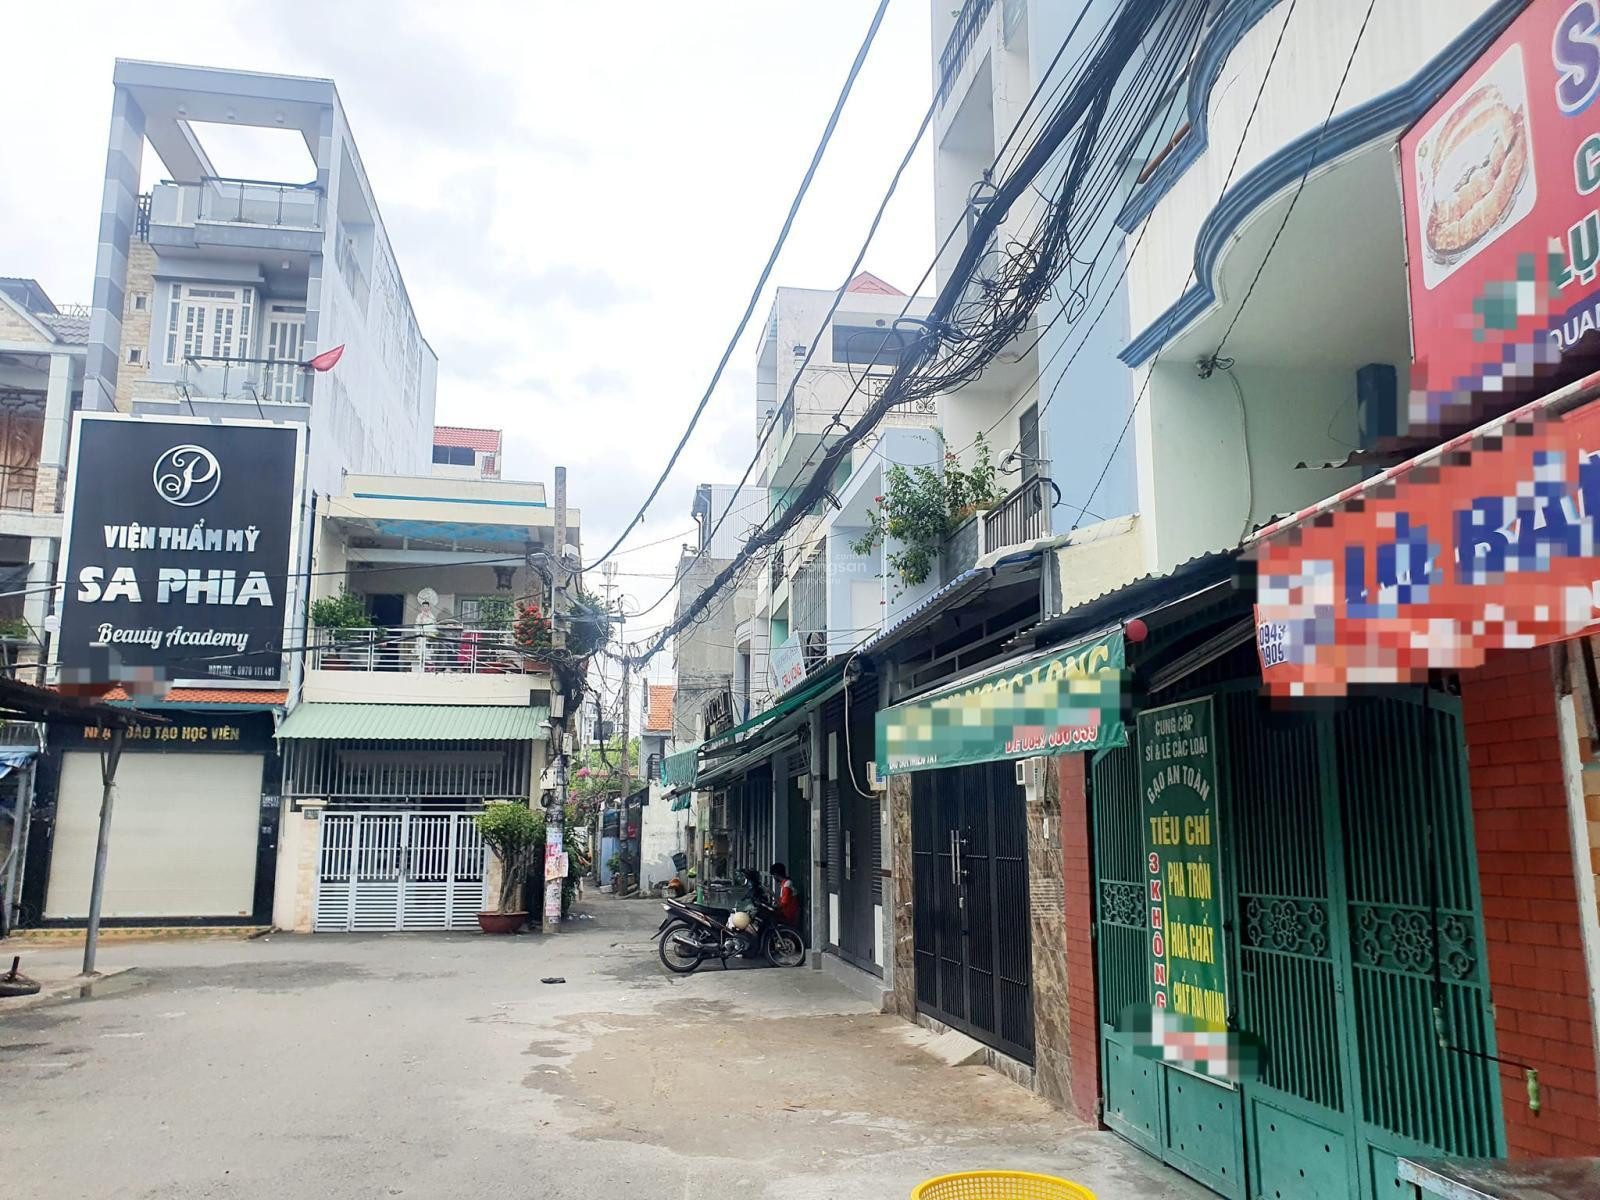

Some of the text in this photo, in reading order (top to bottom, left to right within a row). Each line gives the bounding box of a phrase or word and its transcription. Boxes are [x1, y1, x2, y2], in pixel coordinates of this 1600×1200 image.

[104, 518, 261, 552] VIỆN THẨM MỸ
[77, 566, 274, 607] SA PHIA
[98, 622, 248, 652] Beauty Academy
[154, 726, 178, 741] TẠO
[181, 726, 208, 743] HỌC
[211, 725, 240, 741] VIÊN
[1155, 708, 1194, 736] CUNG CẤP
[1155, 743, 1161, 761] &
[1172, 737, 1188, 758] CÁC
[1189, 735, 1208, 758] LOẠI
[1147, 765, 1210, 804] GẠO AN TOÀN
[1150, 808, 1211, 846] TIÊU CHÍ
[1148, 852, 1160, 874] 3
[1168, 855, 1212, 908] PHA TRỘN
[1171, 913, 1215, 965] HÓA CHẤT
[1173, 970, 1190, 1015] CHẤT
